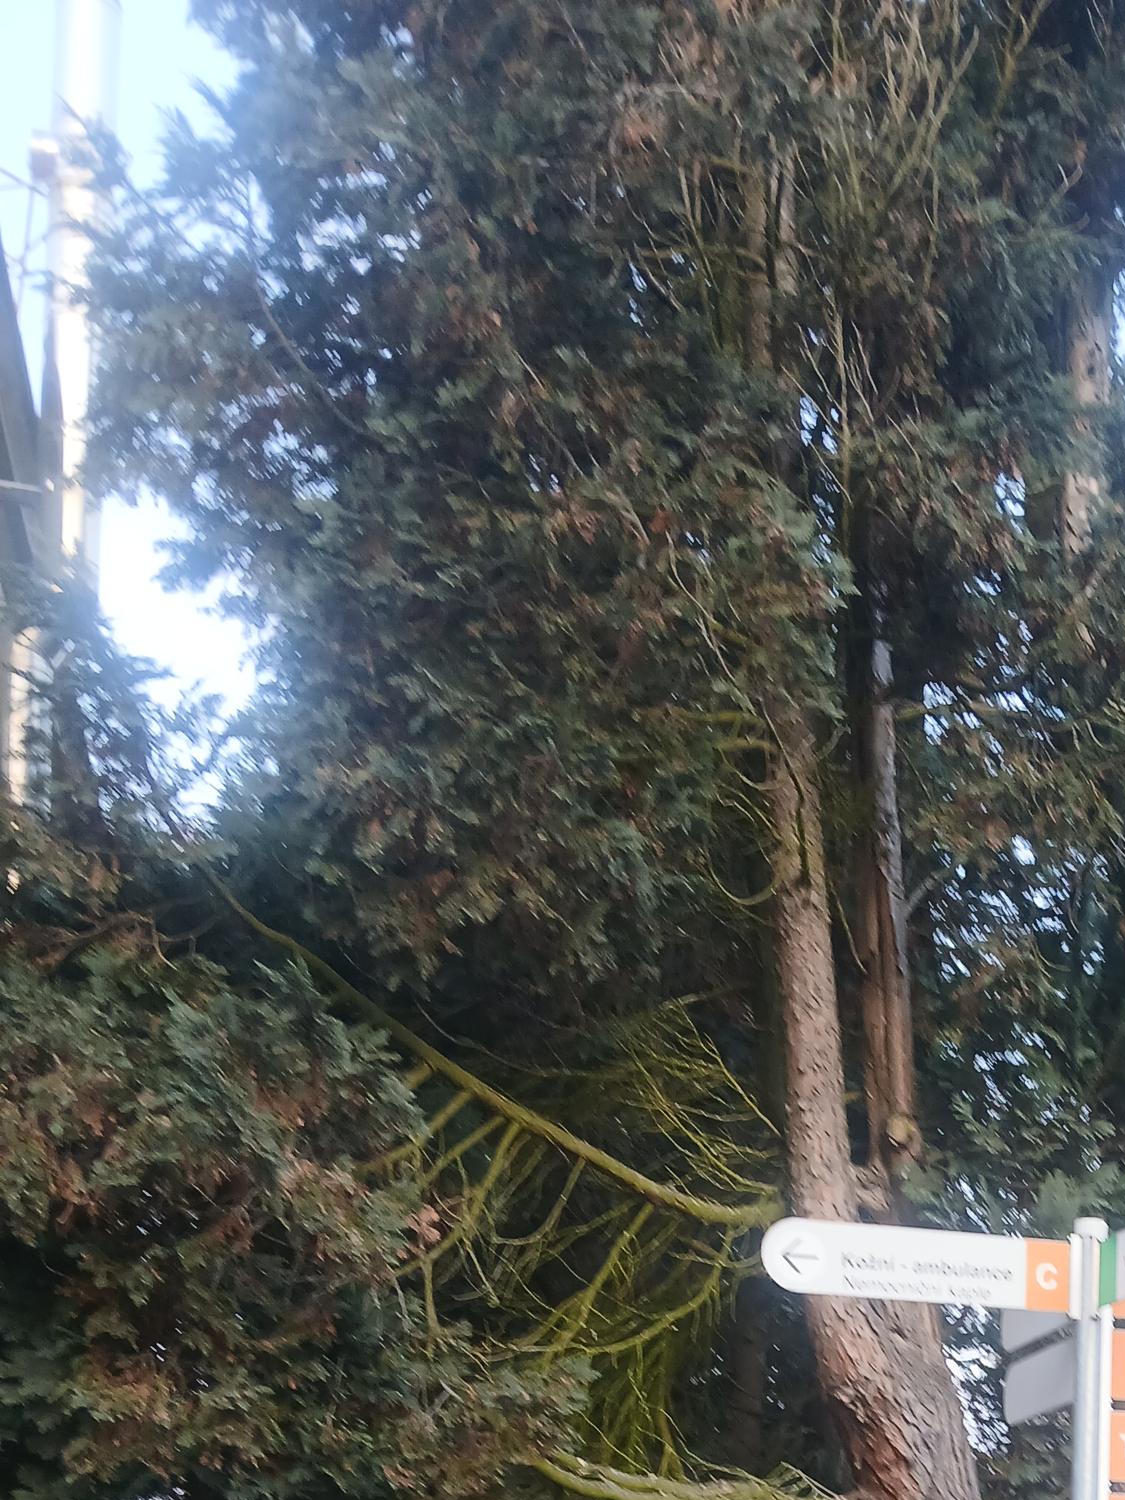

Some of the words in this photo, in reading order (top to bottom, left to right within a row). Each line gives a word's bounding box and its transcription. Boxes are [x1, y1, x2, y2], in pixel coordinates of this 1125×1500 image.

[841, 1250, 896, 1273] Kožní
[911, 1257, 1014, 1281] ambulance
[1035, 1263, 1058, 1290] C
